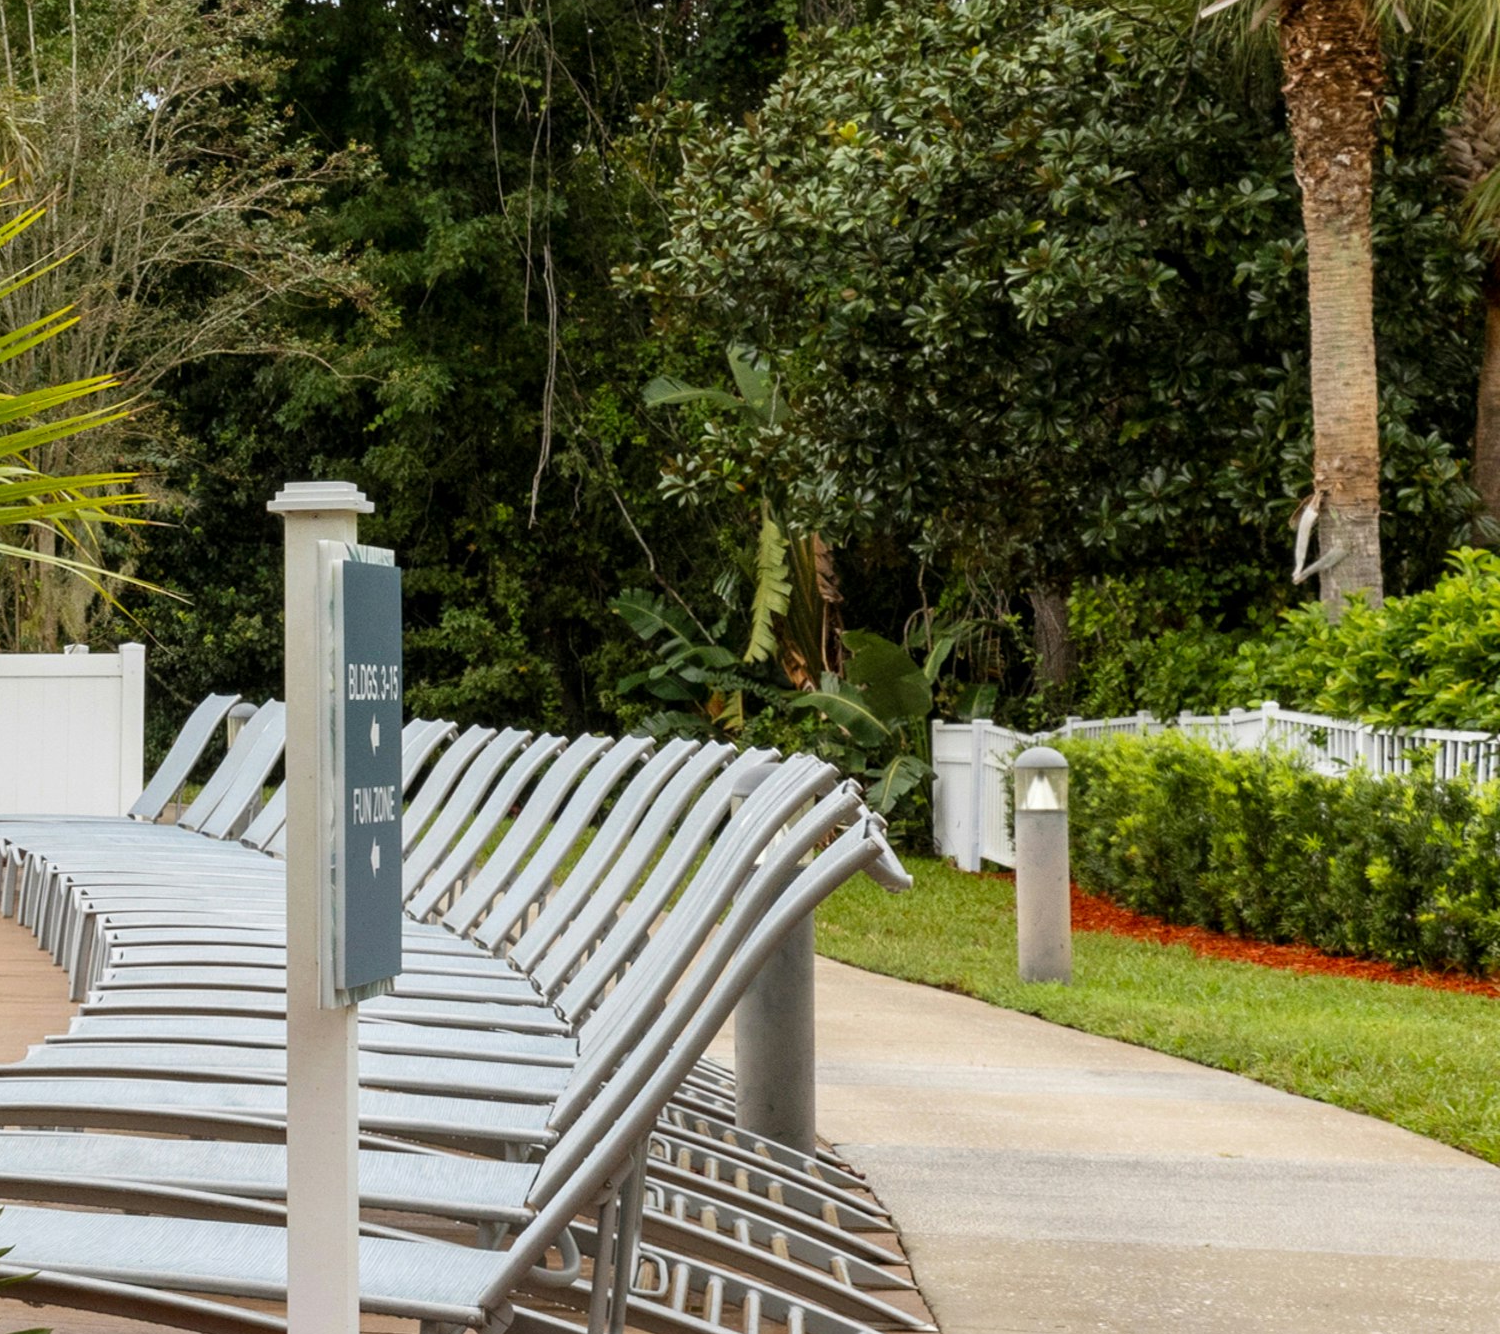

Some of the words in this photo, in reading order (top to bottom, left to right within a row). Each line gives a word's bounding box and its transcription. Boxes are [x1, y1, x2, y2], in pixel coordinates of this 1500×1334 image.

[349, 664, 380, 701] BLDGS.
[381, 665, 398, 701] 3-15
[353, 788, 372, 824] FUN
[374, 786, 395, 822] ZONE
